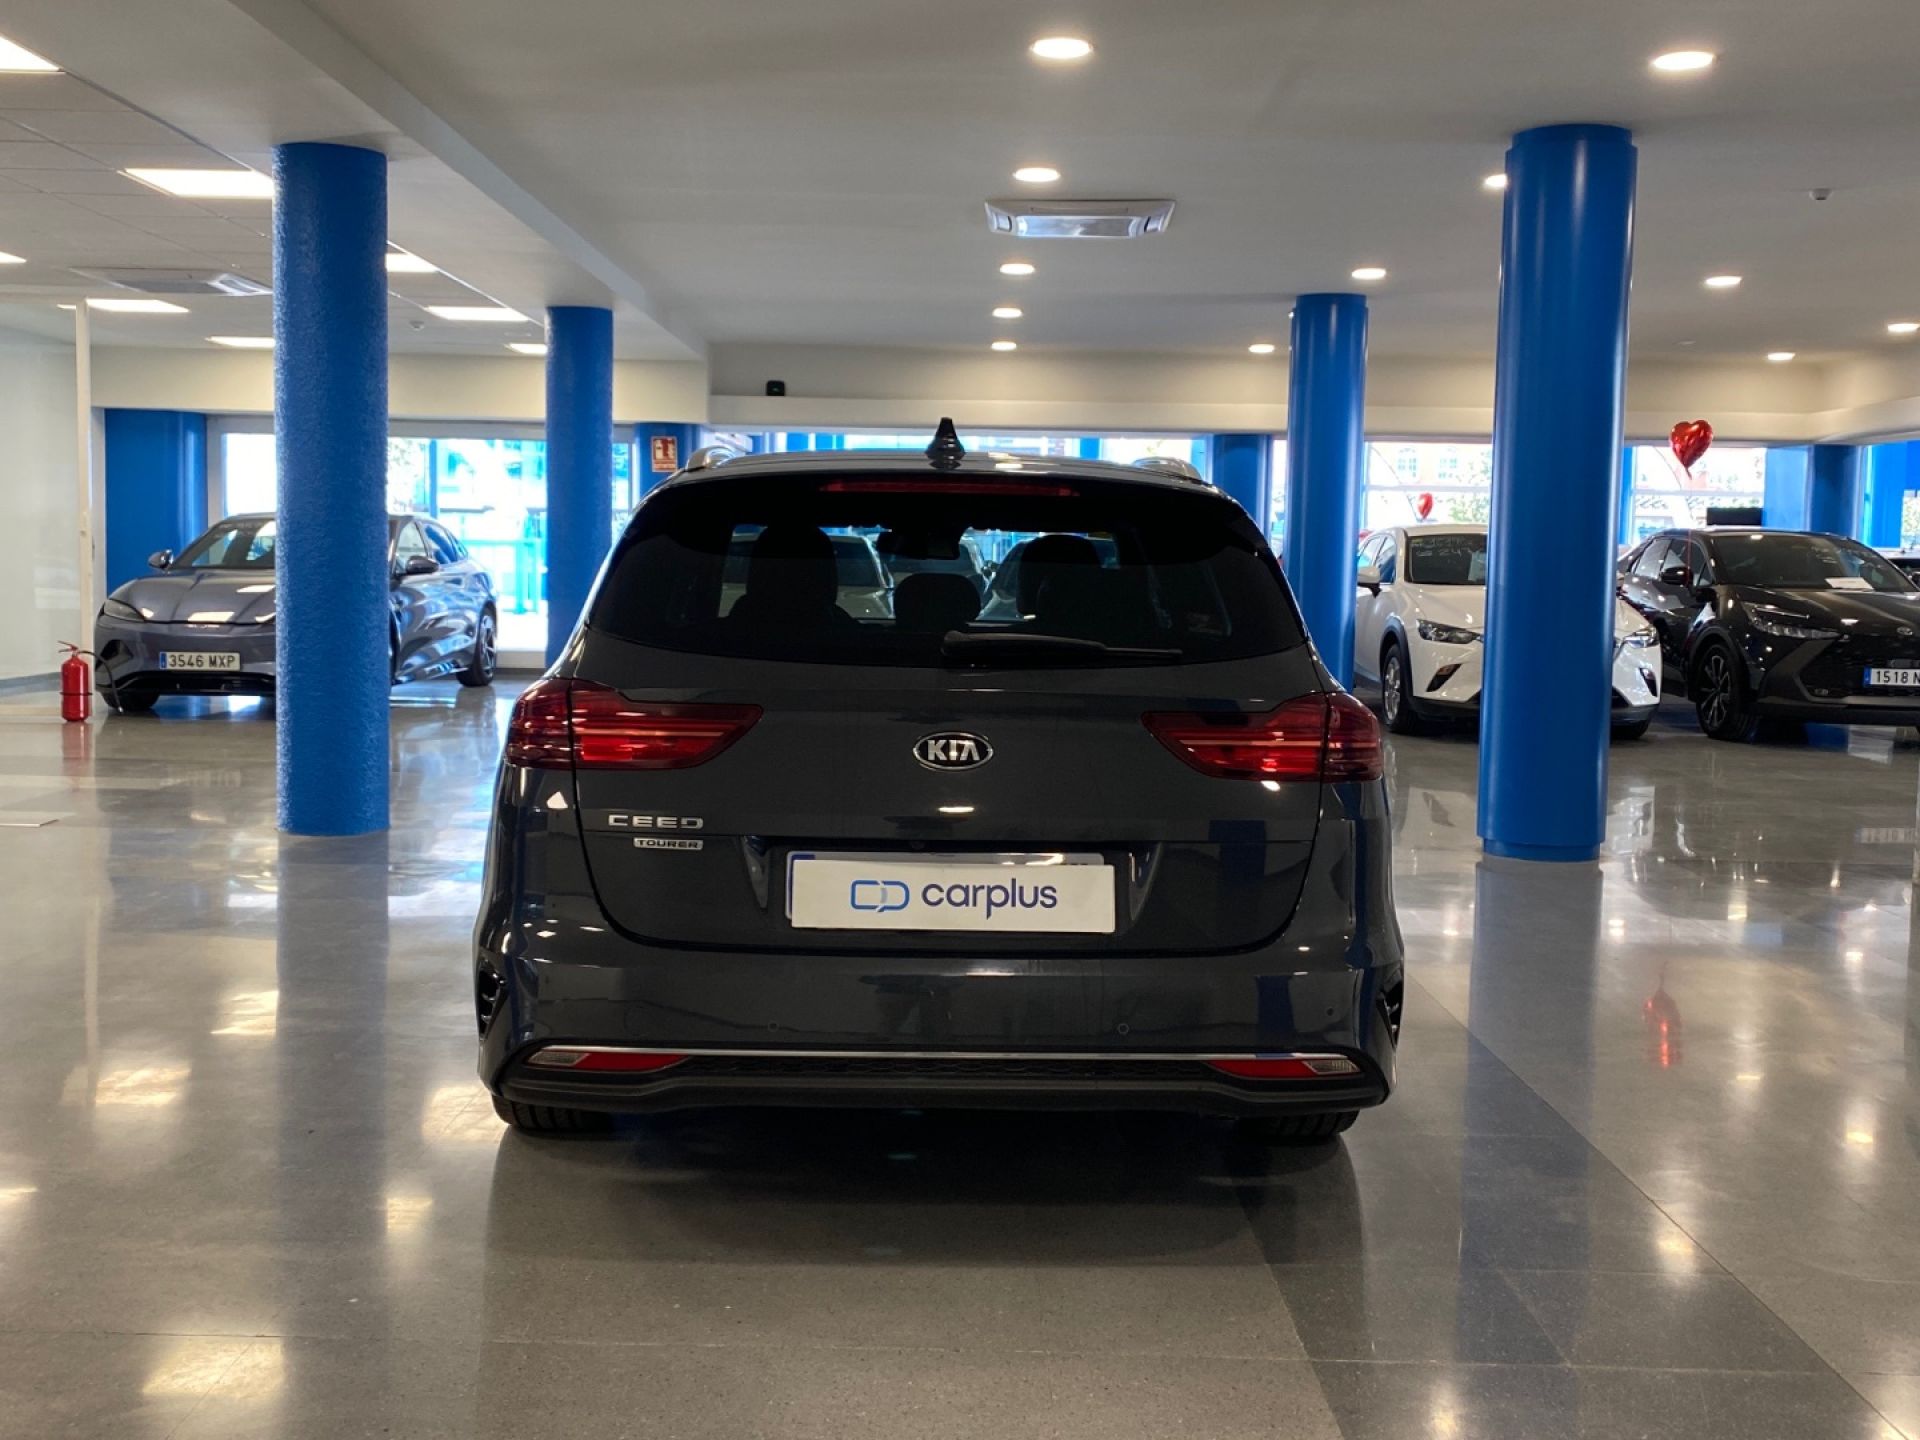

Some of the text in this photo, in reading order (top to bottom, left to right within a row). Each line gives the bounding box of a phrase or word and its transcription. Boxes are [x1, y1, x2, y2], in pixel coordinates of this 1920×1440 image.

[169, 654, 236, 669] 3546 MXP
[1876, 670, 1909, 684] 1518
[927, 739, 980, 761] KIA
[608, 814, 704, 829] CEED
[638, 839, 698, 849] TOURER
[921, 878, 1058, 919] carplus
